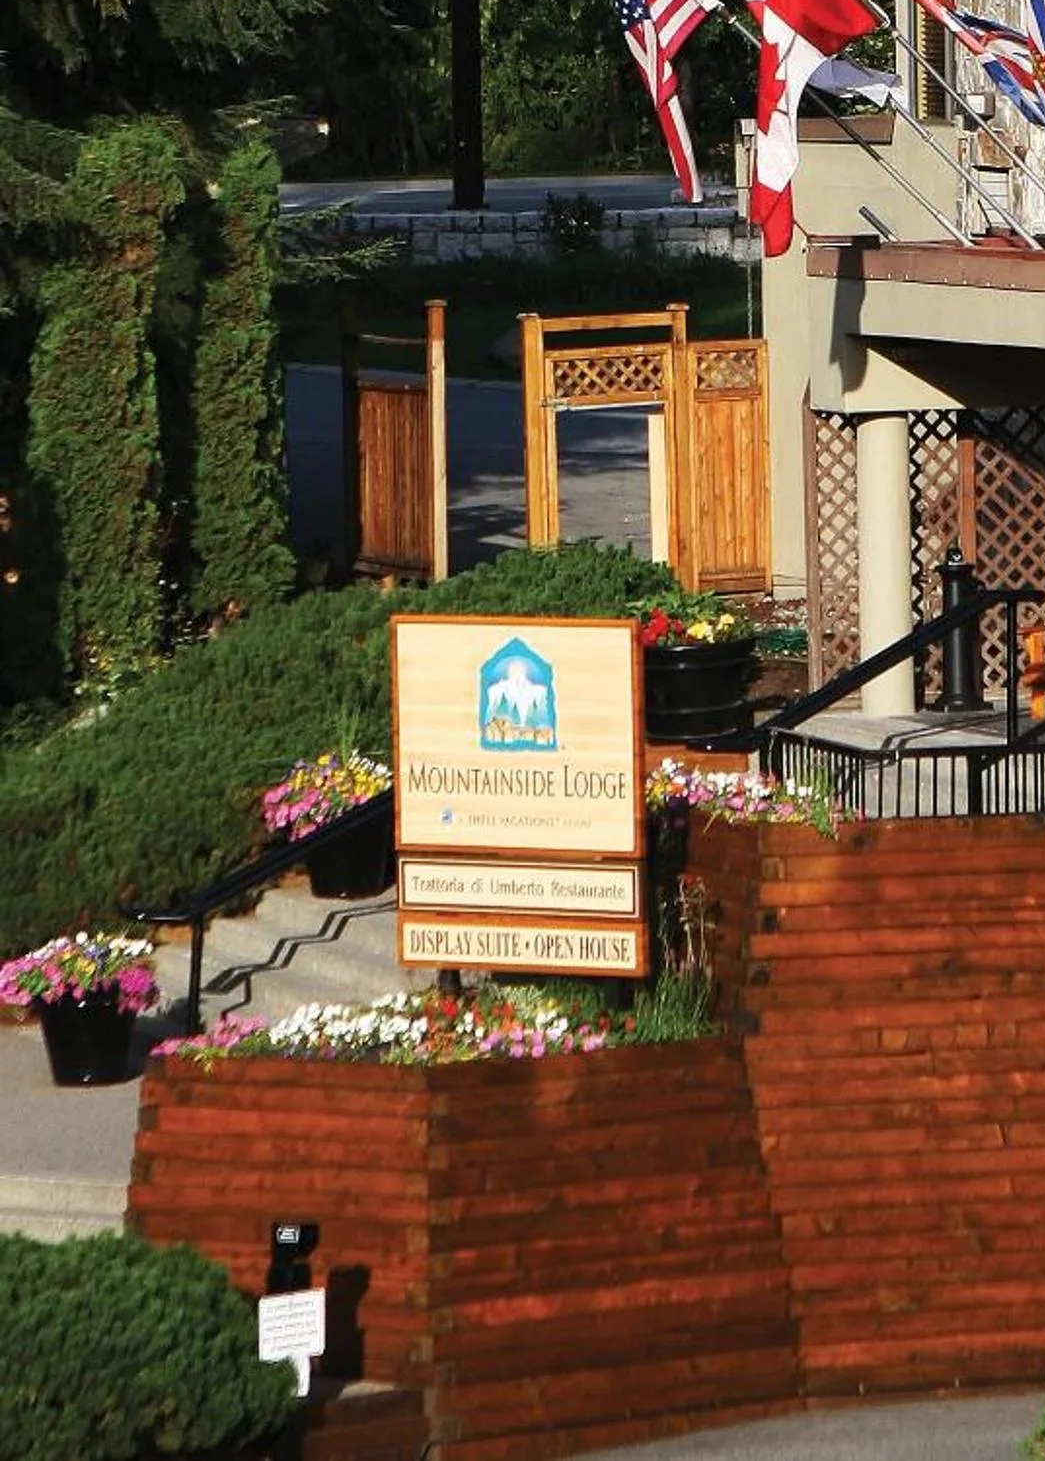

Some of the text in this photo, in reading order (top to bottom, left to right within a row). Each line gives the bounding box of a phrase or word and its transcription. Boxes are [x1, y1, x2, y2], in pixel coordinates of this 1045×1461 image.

[408, 764, 627, 800] MOUNTAINSIDE LODGE
[411, 876, 465, 894] Trattoria
[489, 879, 545, 897] Umberto
[410, 929, 630, 963] DISPLAY SUITE OPEN HOUSE
